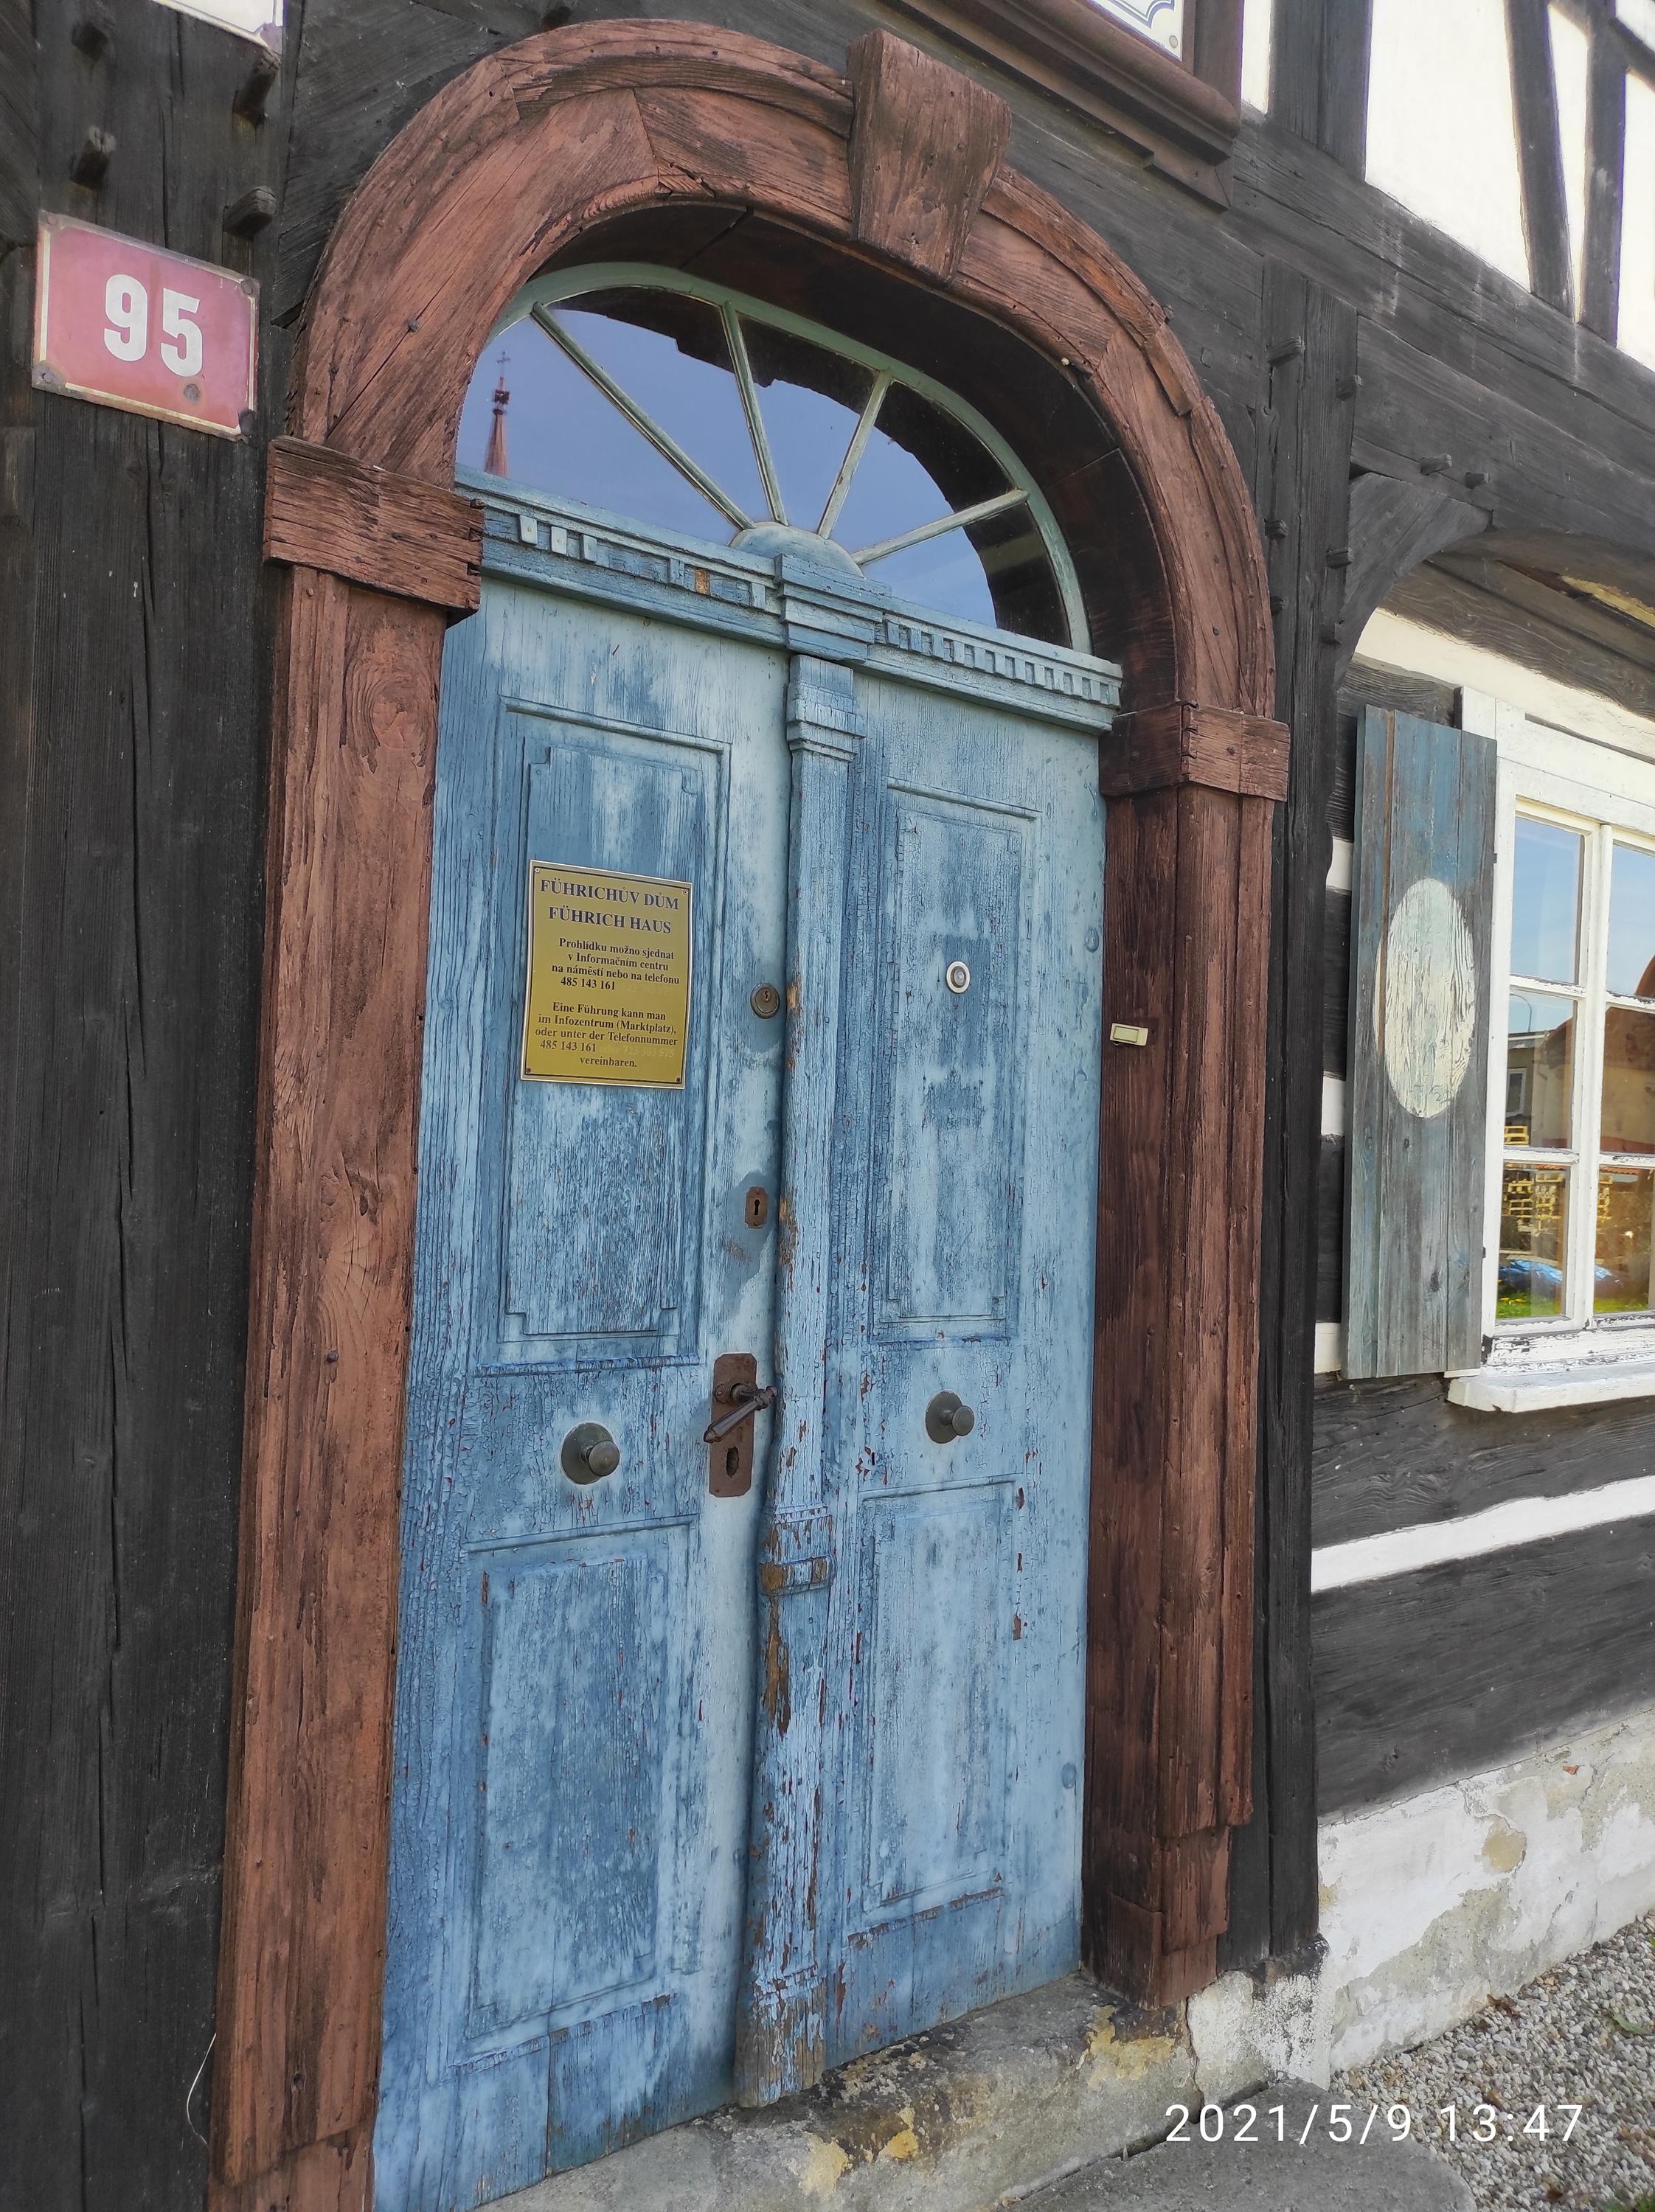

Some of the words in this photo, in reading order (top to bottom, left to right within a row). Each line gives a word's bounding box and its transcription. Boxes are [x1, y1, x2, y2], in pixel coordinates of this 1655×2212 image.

[104, 274, 203, 378] 95
[540, 877, 639, 904] FÜHRICHŮV
[644, 891, 679, 910] DŮM
[548, 905, 625, 928] FÜHRICH
[630, 917, 672, 934] HAUS
[559, 937, 607, 952] Prohlídku
[610, 945, 640, 955] možno
[642, 948, 674, 959] sjednat
[576, 952, 638, 967] Informačním
[639, 961, 669, 971] centru
[552, 964, 563, 973] na
[566, 964, 604, 976] náměstí
[606, 969, 628, 979] nebo
[645, 973, 679, 984] telefonu
[561, 976, 577, 987] 485
[580, 978, 597, 988] 143
[600, 981, 616, 990] 161
[552, 1001, 575, 1013] Eine
[577, 1004, 619, 1018] Führung
[621, 1007, 644, 1018] kann
[647, 1012, 666, 1020] man
[538, 1013, 551, 1024] im
[554, 1015, 614, 1029] Infozentrum
[617, 1019, 676, 1034] (Marktplatz),
[535, 1027, 556, 1037] oder
[561, 1031, 586, 1039] unter
[589, 1030, 605, 1040] der
[608, 1032, 678, 1046] Telefonnummer
[540, 1039, 557, 1050] 485
[561, 1040, 577, 1051] 143
[580, 1042, 596, 1052] 161
[580, 1056, 637, 1068] vereinbaren.
